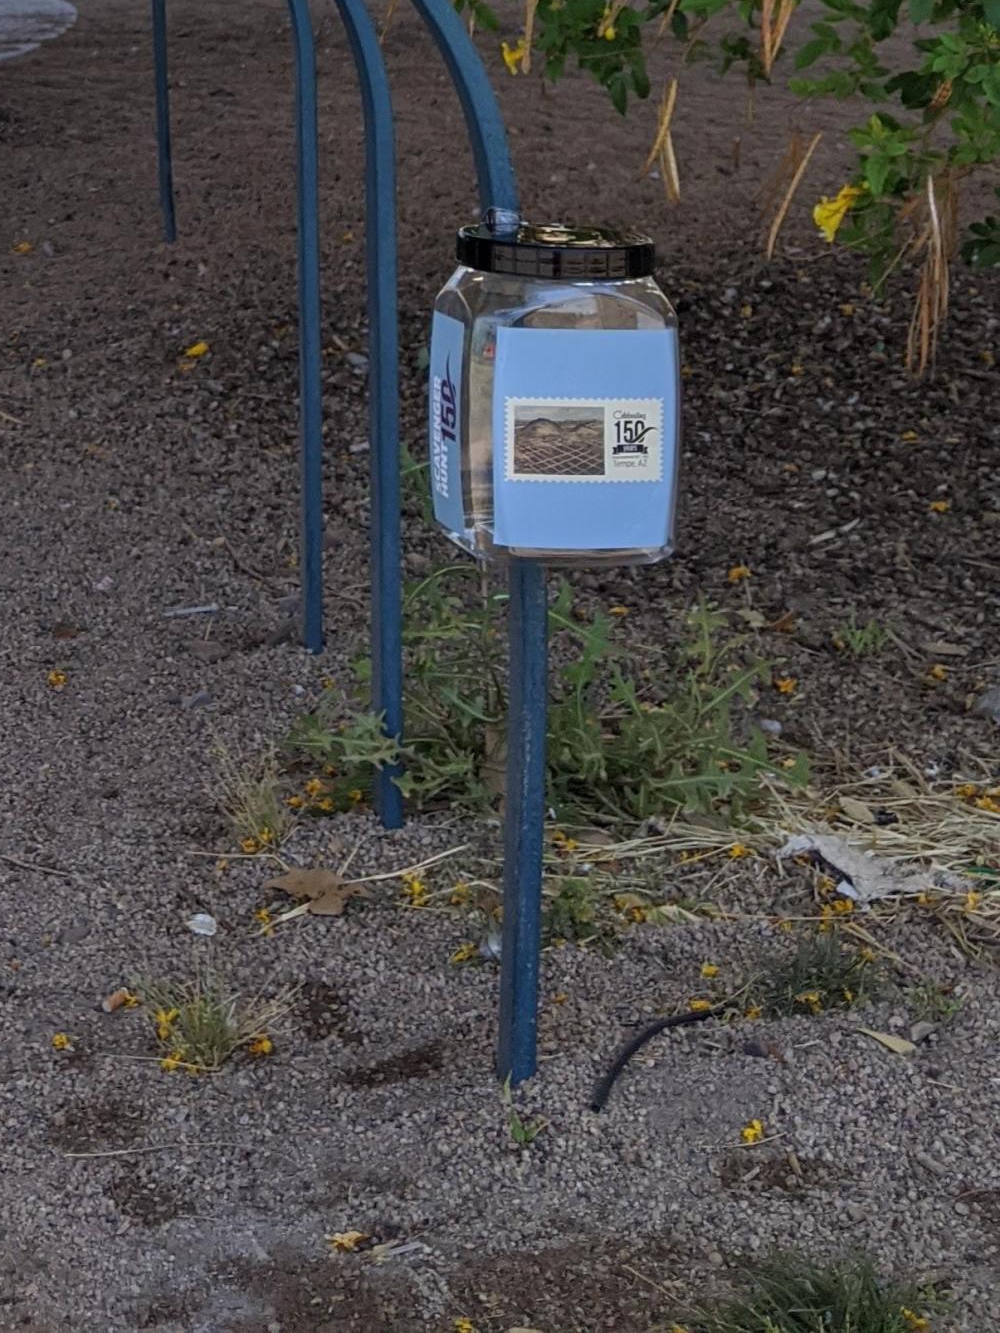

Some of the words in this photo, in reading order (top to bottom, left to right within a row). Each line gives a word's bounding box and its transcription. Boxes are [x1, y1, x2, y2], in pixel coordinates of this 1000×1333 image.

[433, 376, 442, 493] SCAVENGER
[441, 367, 456, 442] 150
[614, 420, 652, 444] 150
[440, 443, 449, 499] HUNT
